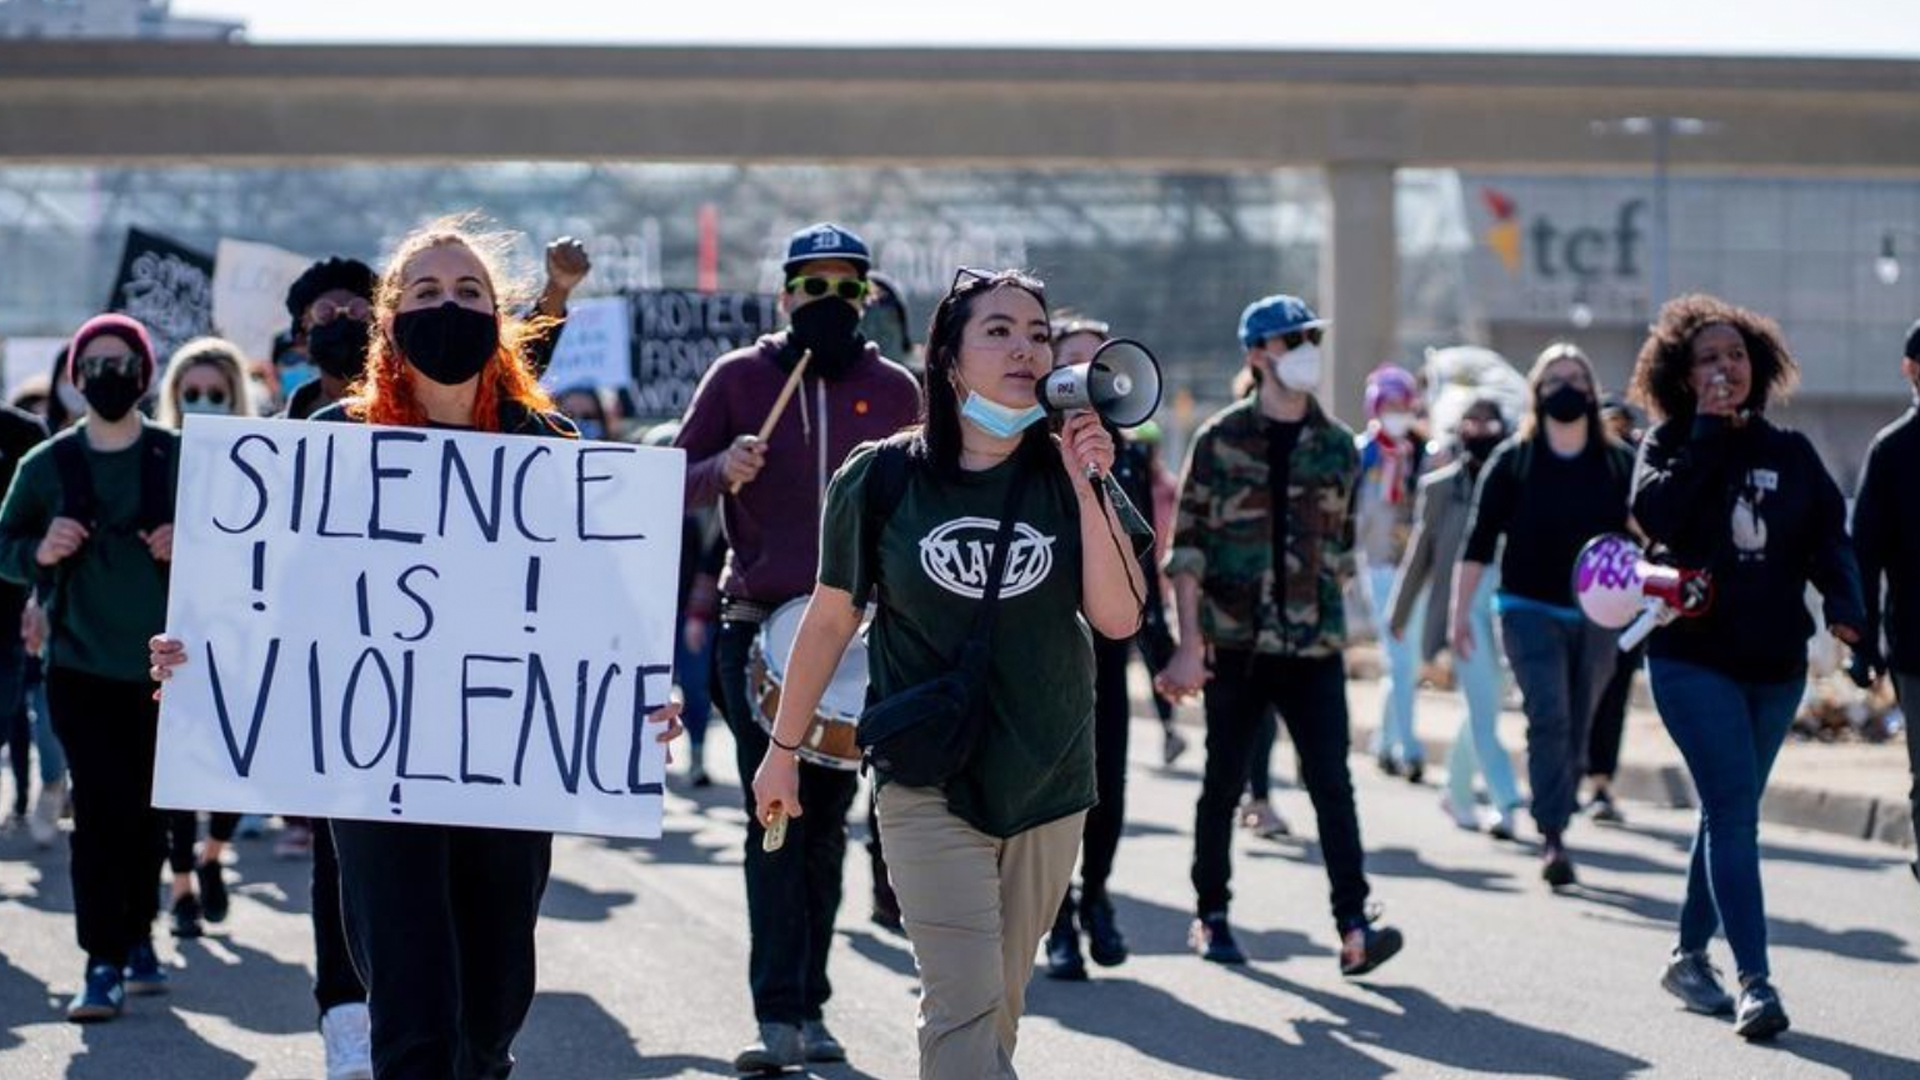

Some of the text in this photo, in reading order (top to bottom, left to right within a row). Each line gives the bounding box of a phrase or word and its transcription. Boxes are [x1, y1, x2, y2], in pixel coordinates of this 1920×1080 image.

[1531, 197, 1647, 278] tcf
[212, 430, 646, 544] SILENCE
[357, 564, 440, 642] IS
[206, 637, 672, 796] VIOLENCE
